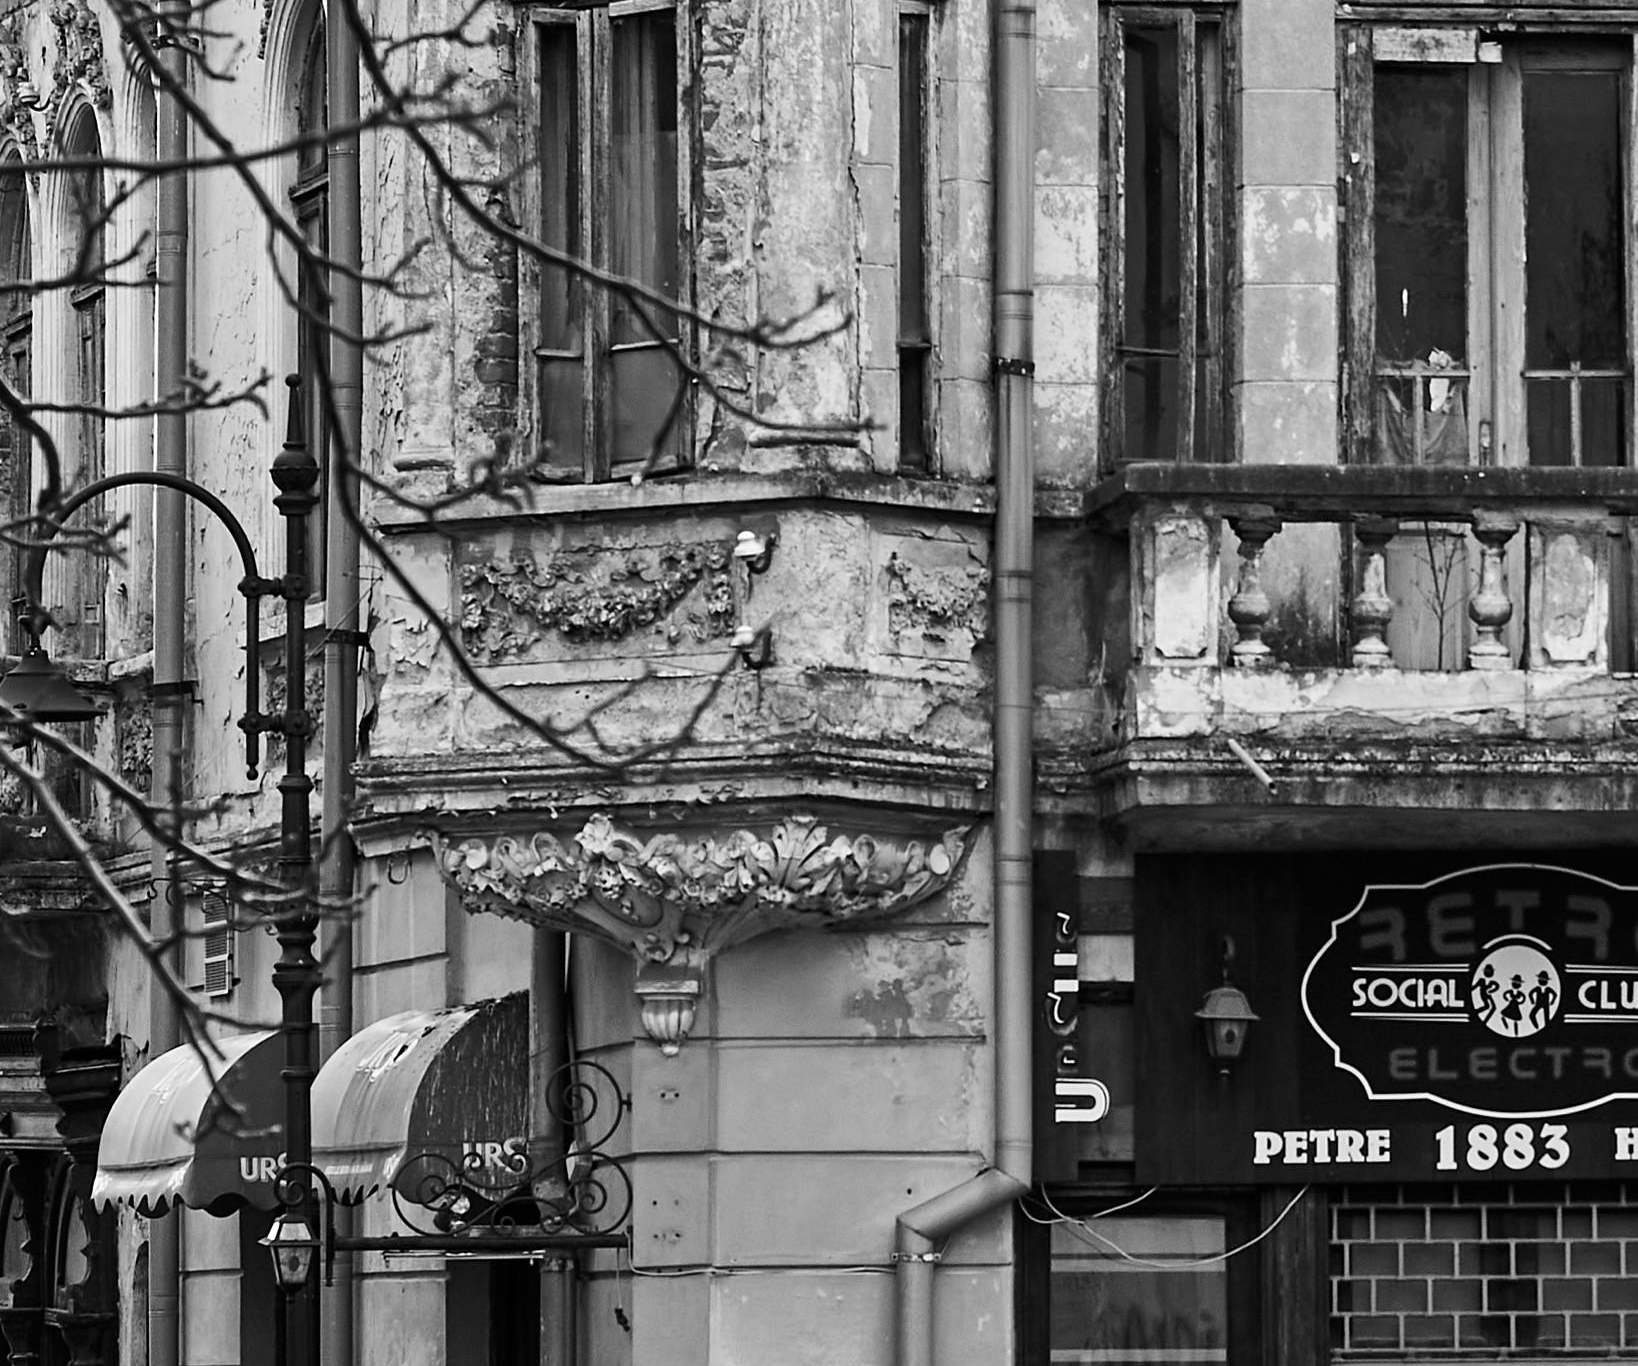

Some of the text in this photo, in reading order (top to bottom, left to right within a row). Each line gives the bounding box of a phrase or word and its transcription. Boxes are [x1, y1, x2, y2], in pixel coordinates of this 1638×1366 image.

[1353, 978, 1465, 1008] SOCIAL
[1253, 1129, 1391, 1164] PETRE
[1436, 1123, 1571, 1170] 1883
